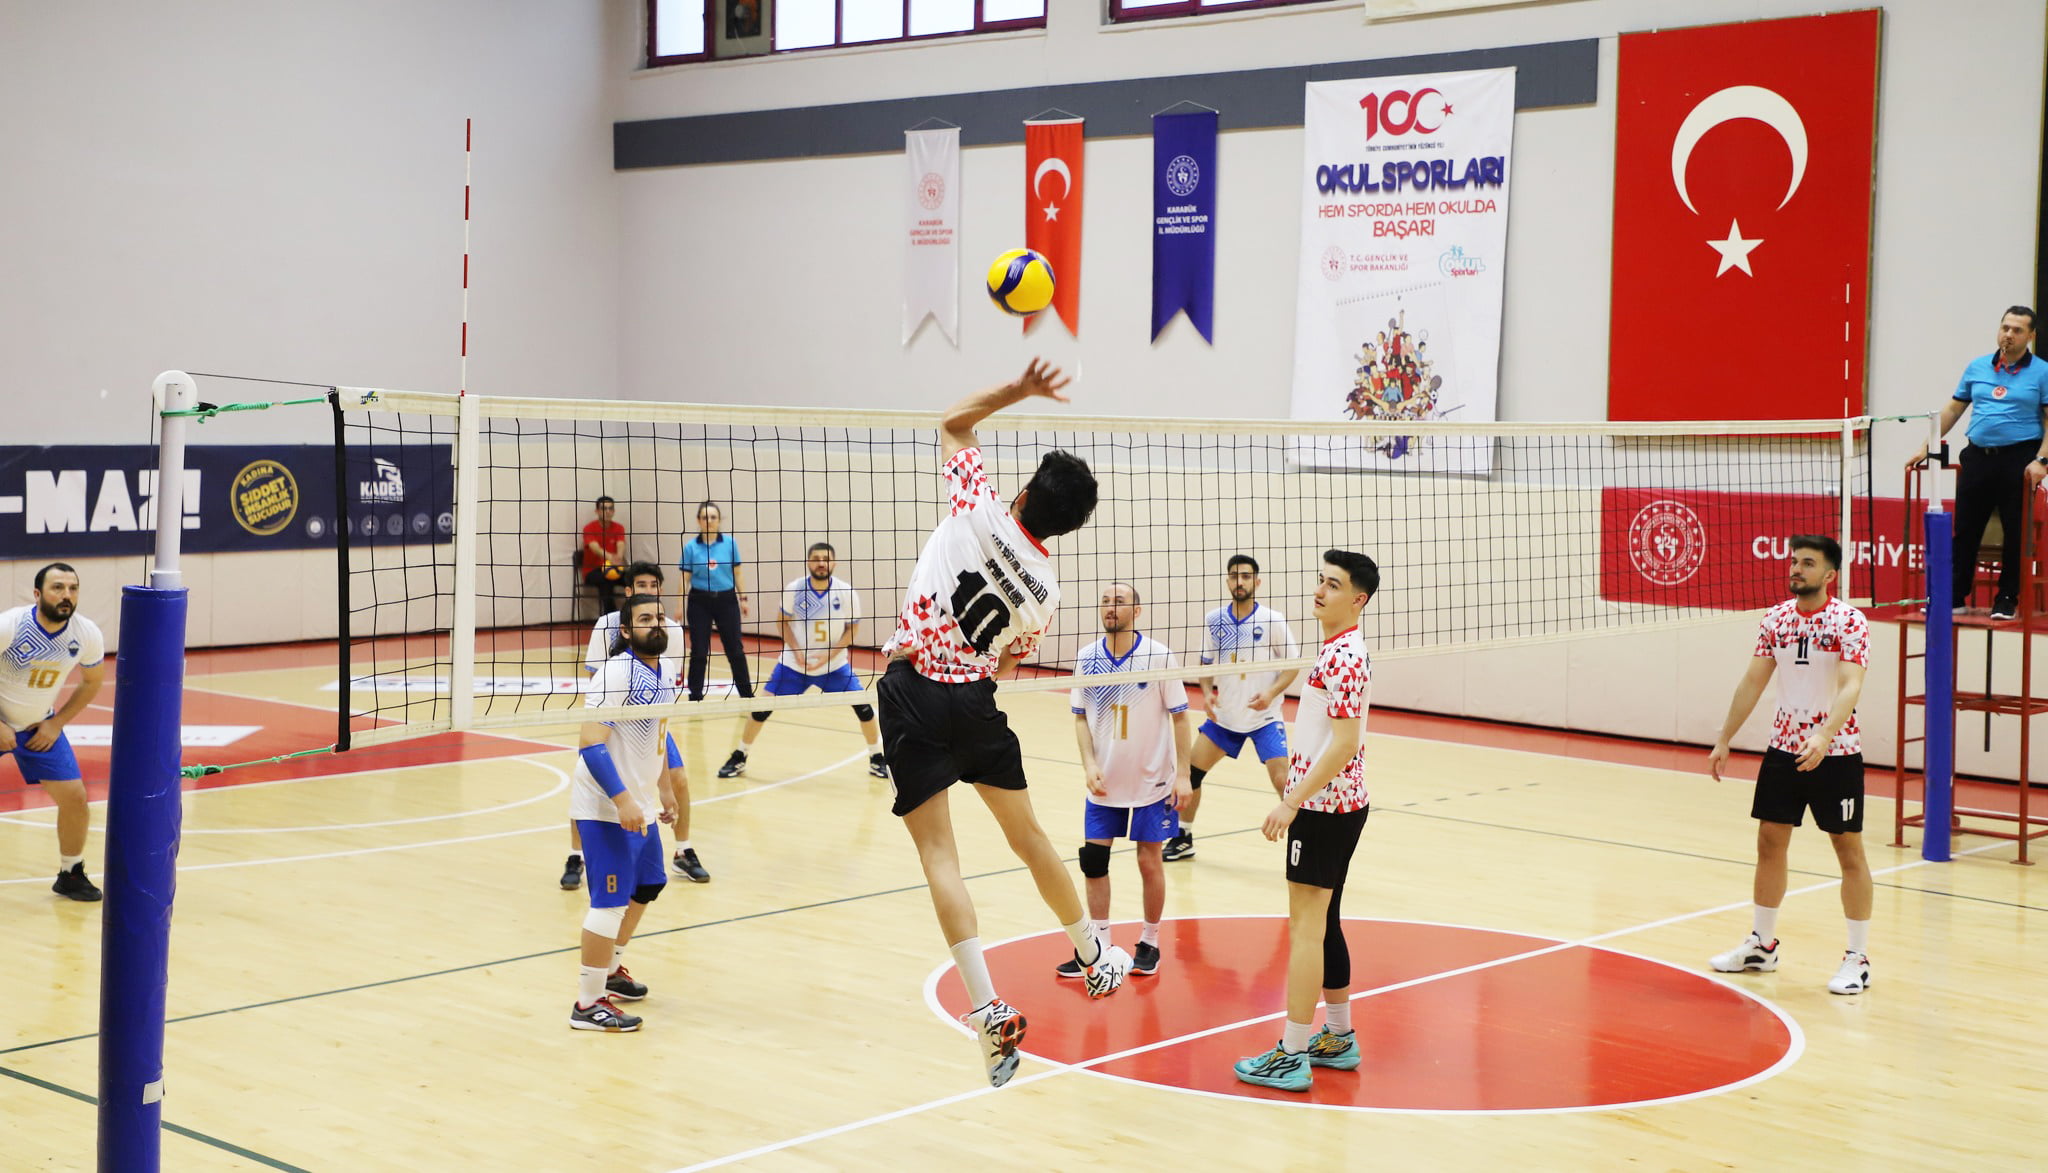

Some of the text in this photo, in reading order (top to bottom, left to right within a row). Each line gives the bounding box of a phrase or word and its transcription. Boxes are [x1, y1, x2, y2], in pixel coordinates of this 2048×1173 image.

[1316, 156, 1505, 194] OKUL SPORLARI
[1167, 204, 1197, 214] KARABÜK
[1191, 215, 1208, 223] SPOR
[1318, 199, 1496, 218] HEM SPORDA HEM OKULDA
[1373, 219, 1435, 240] BAŞARI
[1350, 264, 1368, 272] SPOR
[1399, 254, 1408, 262] VE
[360, 481, 404, 497] KADES
[950, 569, 1011, 657] 10
[814, 621, 827, 642] 5
[1796, 637, 1809, 660] 11
[28, 668, 61, 689] 10
[1110, 703, 1129, 740] 11
[1840, 798, 1855, 822] 11
[1290, 839, 1302, 867] 6
[606, 875, 617, 894] 8
